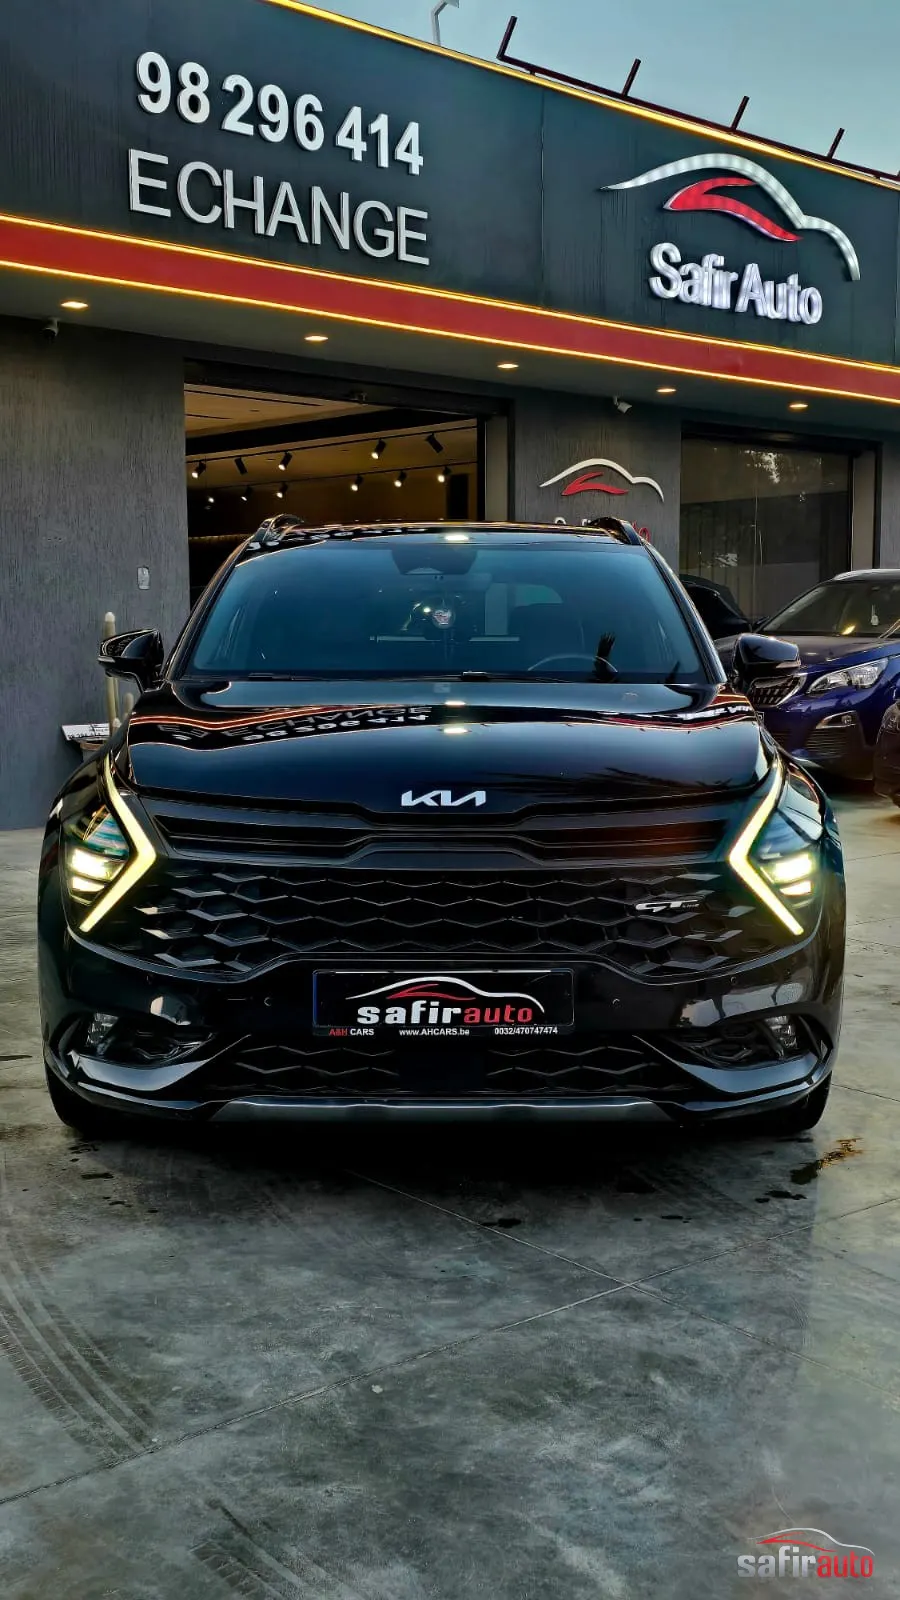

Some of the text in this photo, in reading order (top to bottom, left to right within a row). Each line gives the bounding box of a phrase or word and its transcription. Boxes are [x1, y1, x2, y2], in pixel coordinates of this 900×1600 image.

[136, 51, 424, 176] 98 296 414
[129, 148, 430, 266] ECHANGE
[650, 242, 823, 325] Safir Auto
[400, 790, 487, 807] KIA
[350, 1028, 375, 1036] CARS
[399, 1028, 470, 1036] www.AHCARS.be
[494, 1026, 558, 1035] 0032/470747474
